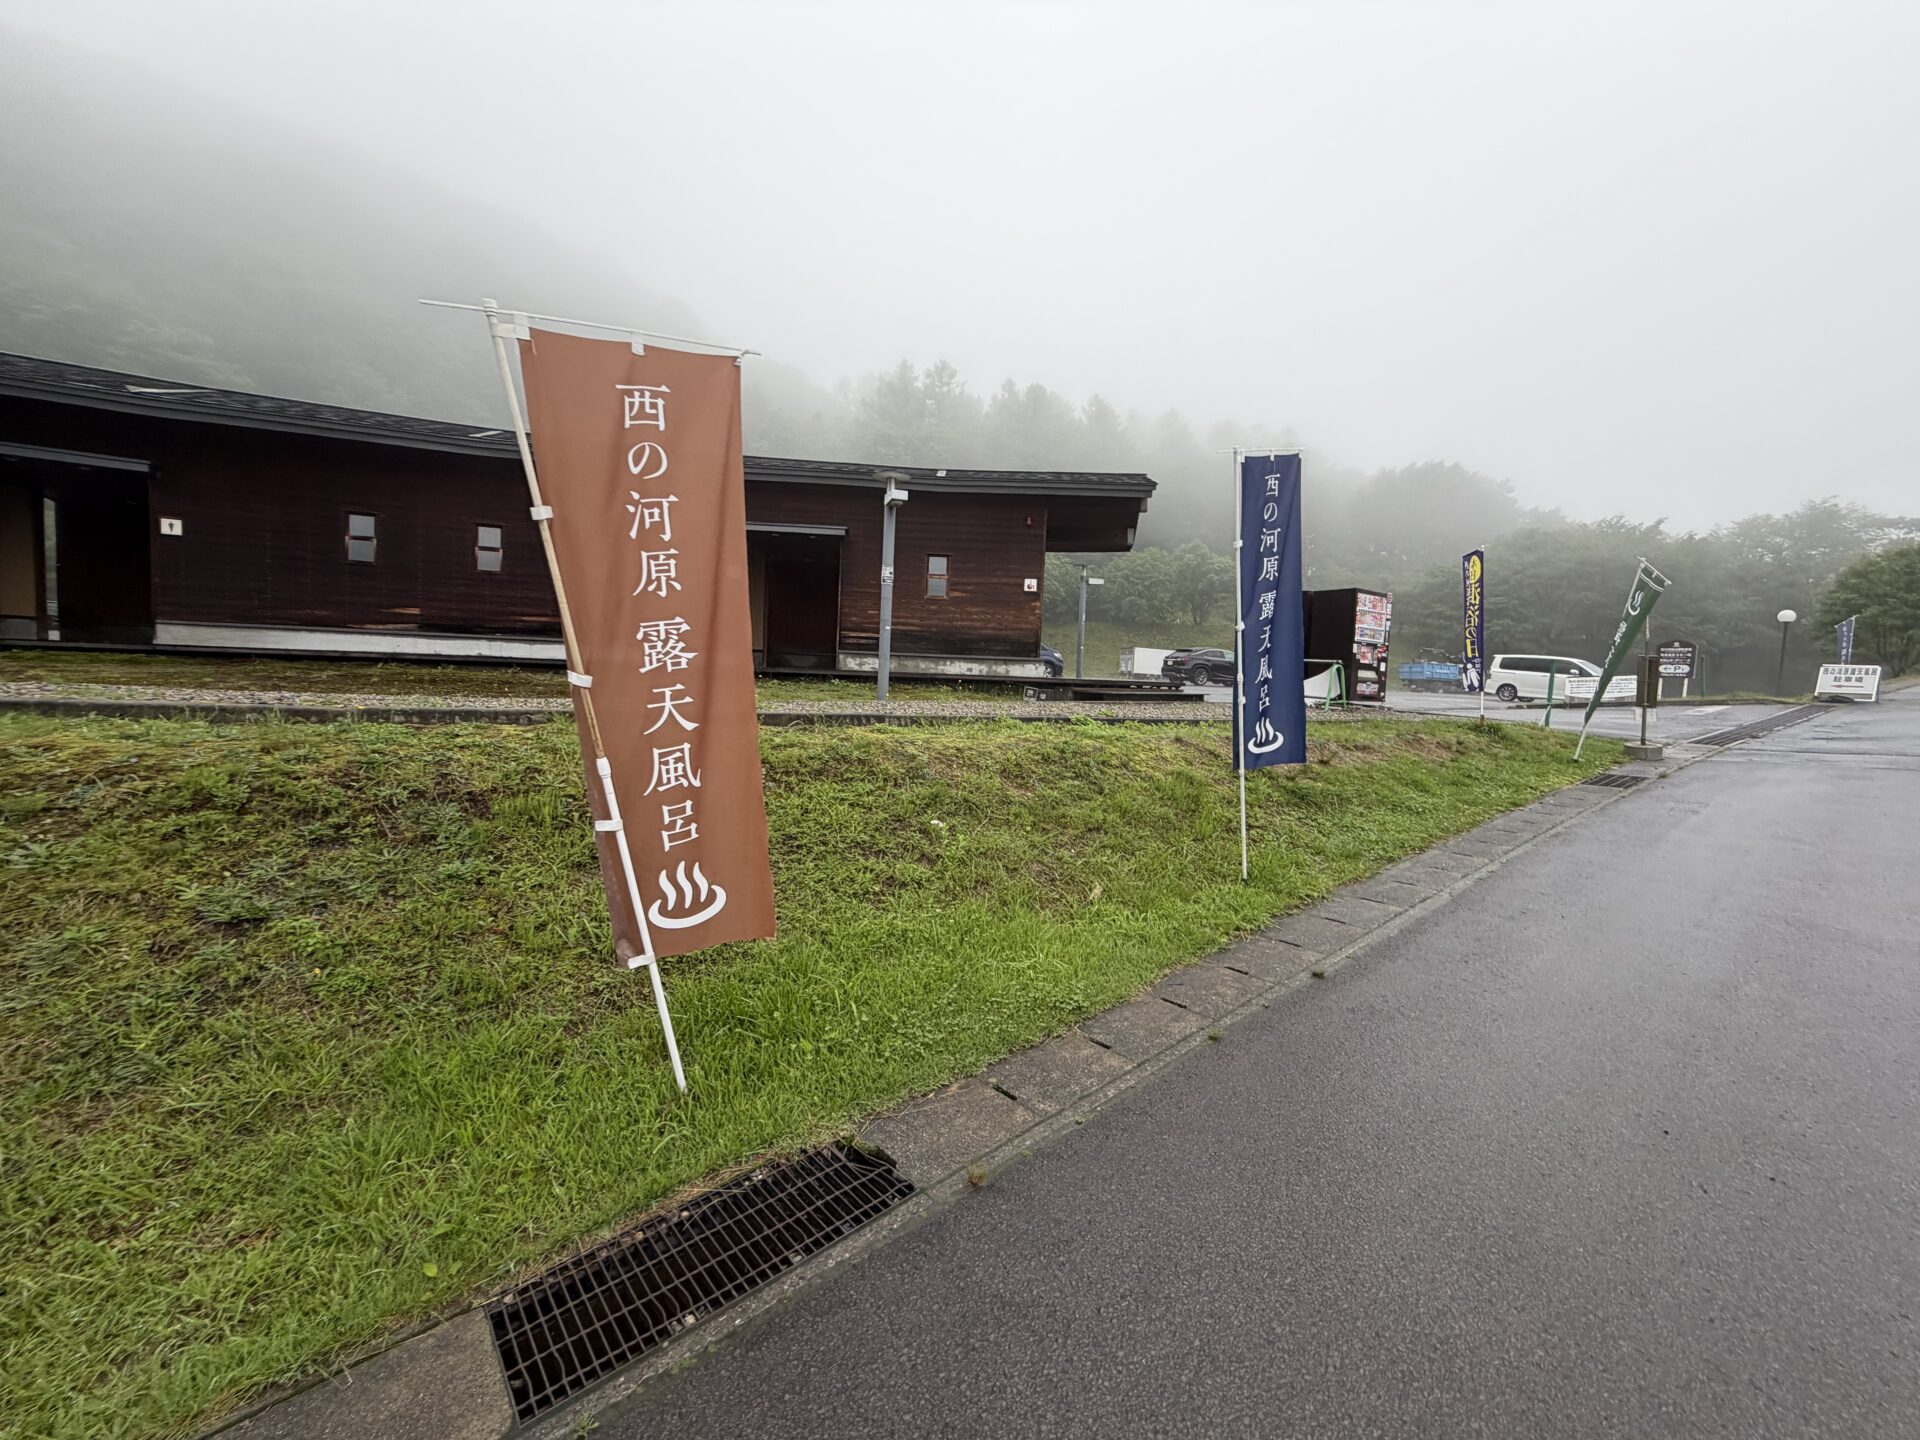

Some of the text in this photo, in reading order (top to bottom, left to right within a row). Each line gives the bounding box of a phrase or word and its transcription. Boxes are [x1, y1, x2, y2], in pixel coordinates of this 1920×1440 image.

[614, 383, 702, 853] 西の河原露天風呂
[1254, 473, 1282, 713] 西の河原露天風呂
